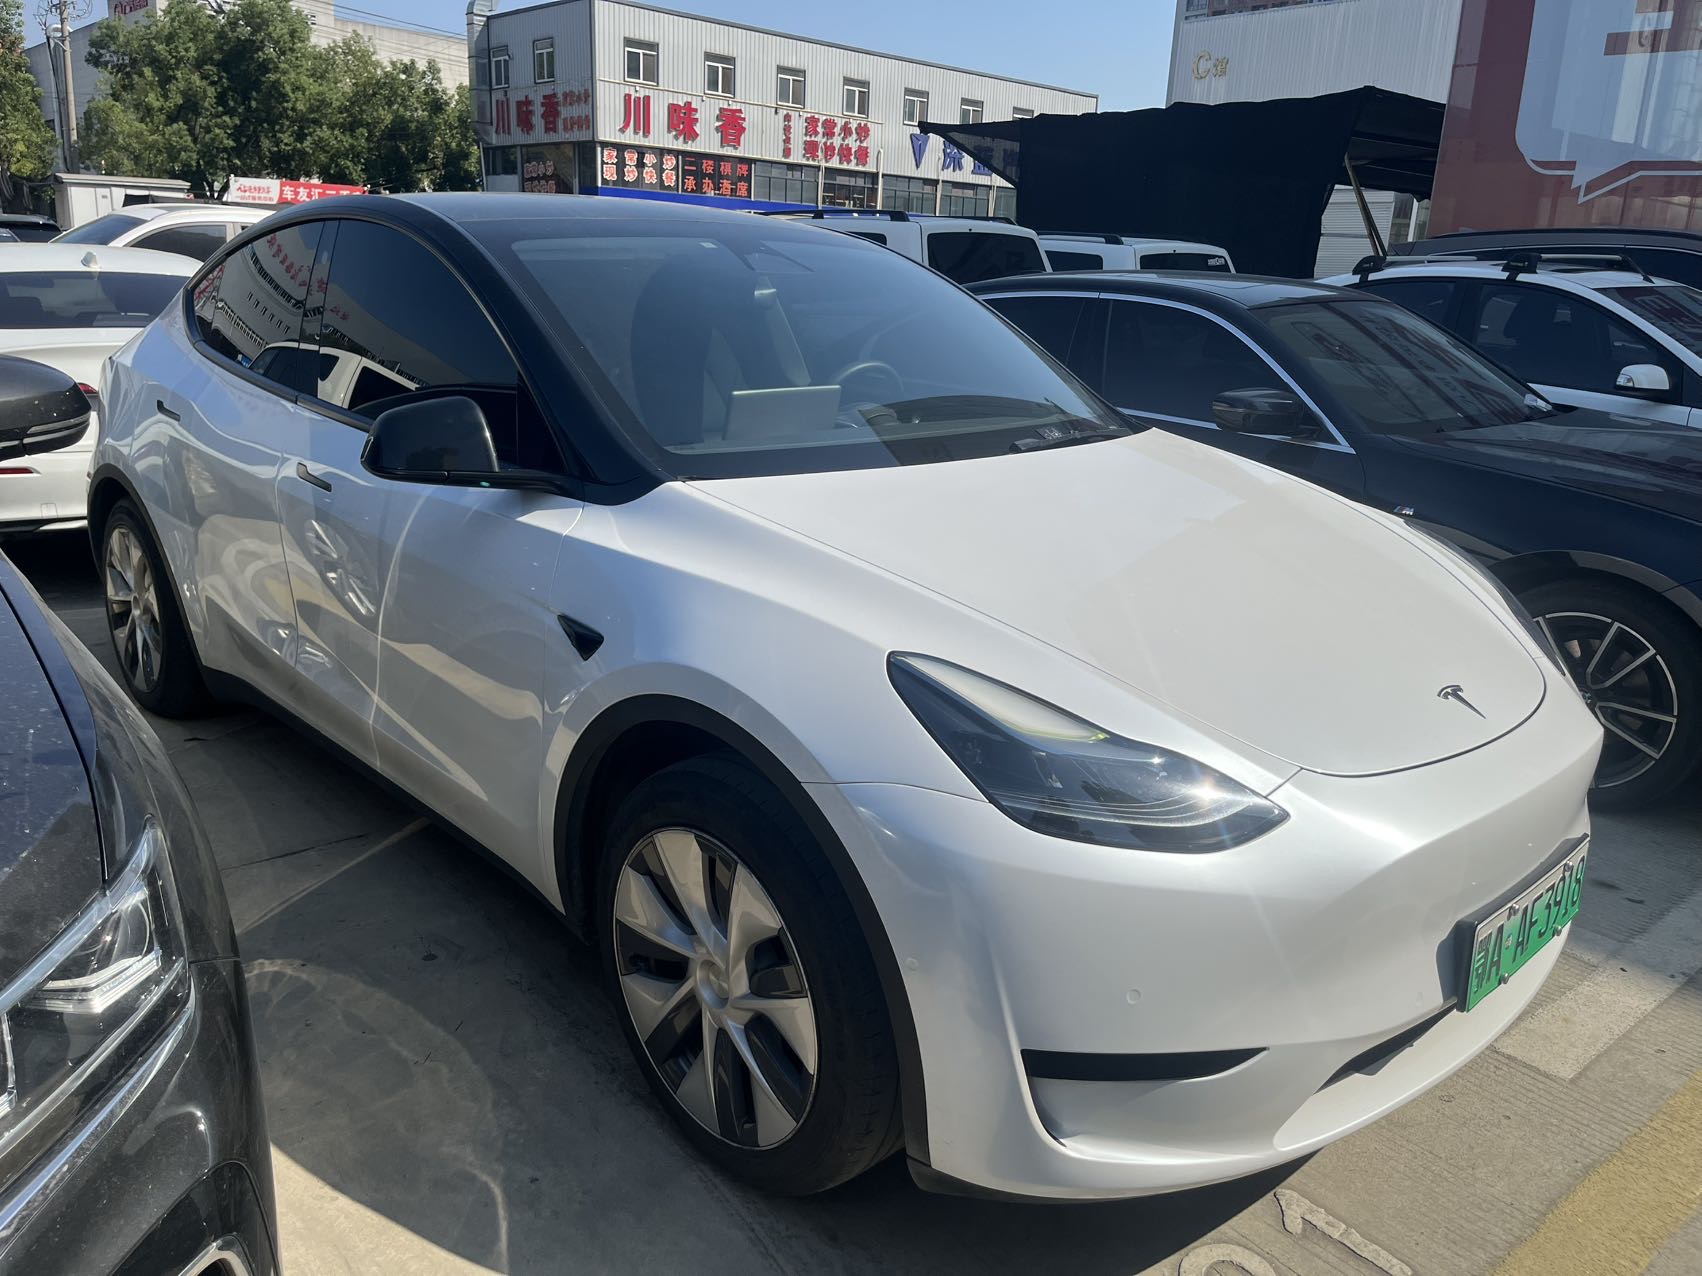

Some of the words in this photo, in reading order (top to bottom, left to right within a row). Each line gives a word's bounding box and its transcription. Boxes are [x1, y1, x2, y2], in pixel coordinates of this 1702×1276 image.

[495, 93, 560, 135] 川味香
[619, 93, 747, 148] 川味香
[804, 115, 871, 142] 家常小炒
[603, 147, 676, 170] 家常小炒
[803, 140, 870, 167] 现炒快餐
[603, 163, 676, 187] 现炒快餐
[684, 157, 749, 177] 二楼棋牌
[684, 175, 749, 197] 承办酒席
